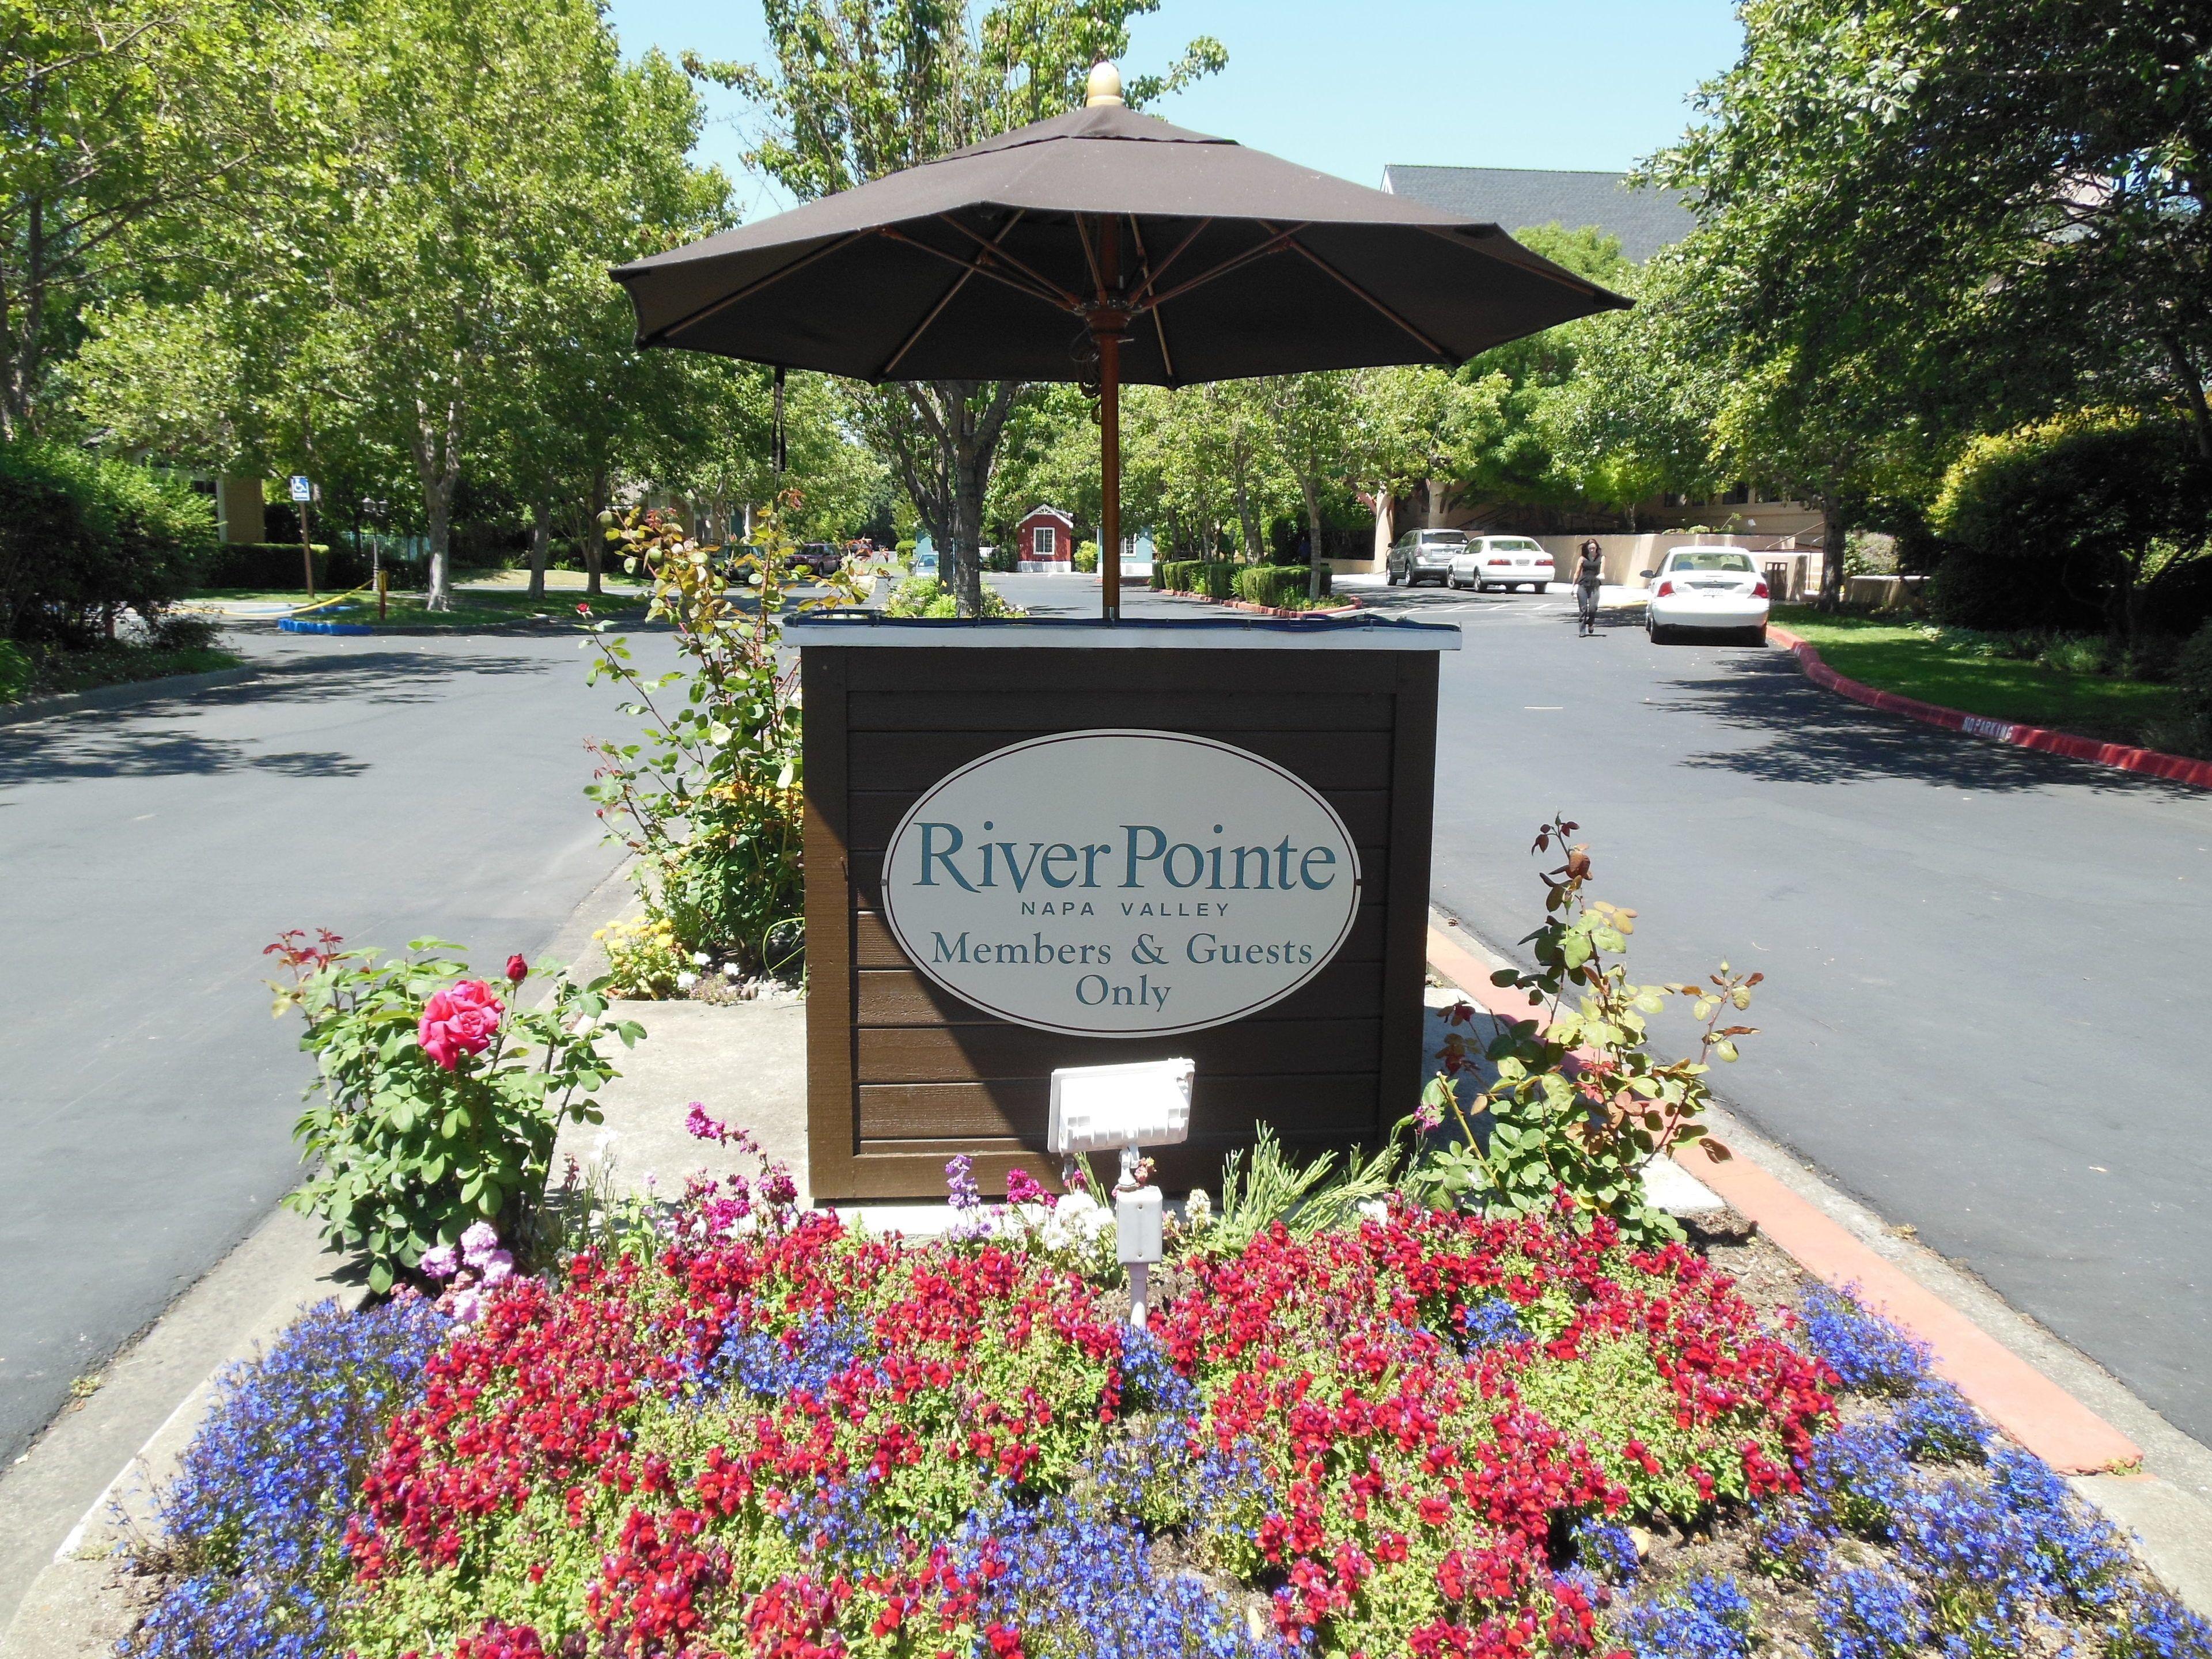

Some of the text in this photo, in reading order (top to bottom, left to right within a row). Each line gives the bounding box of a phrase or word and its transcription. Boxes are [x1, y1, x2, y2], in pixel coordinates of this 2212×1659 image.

[1962, 716, 2013, 739] NO PARKING
[1021, 901, 1229, 916] NAPA VALLEY
[930, 931, 1312, 965] Members & Guests
[1075, 974, 1172, 1013] Only
